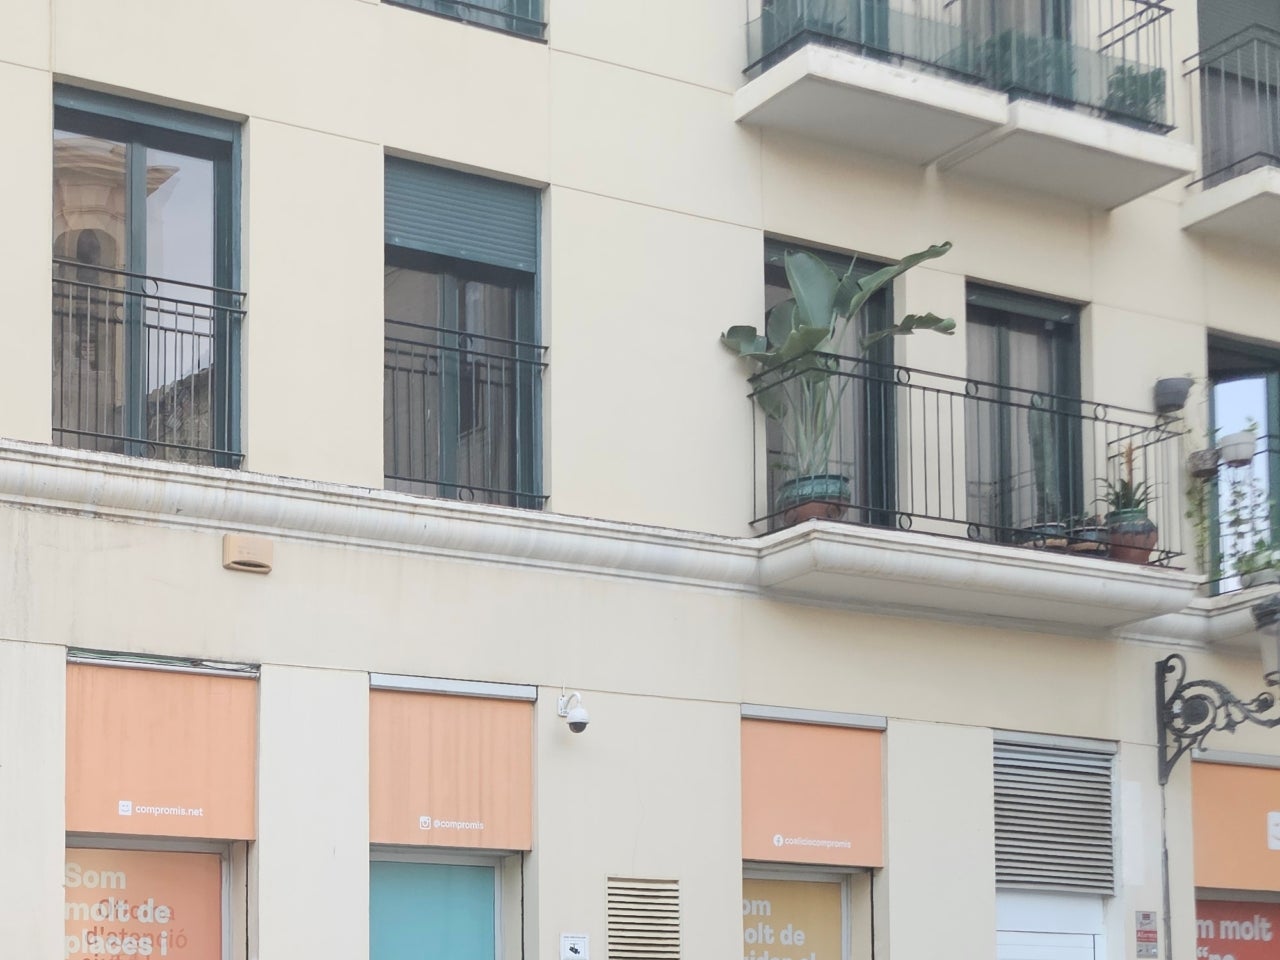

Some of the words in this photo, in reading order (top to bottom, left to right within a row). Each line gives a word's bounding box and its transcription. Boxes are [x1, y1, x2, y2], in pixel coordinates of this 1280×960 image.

[65, 862, 127, 889] Som
[65, 896, 130, 923] molt
[137, 897, 171, 924] de
[742, 899, 771, 916] om
[744, 922, 775, 945] olt
[780, 923, 805, 946] de
[1220, 914, 1274, 942] molt
[64, 928, 153, 960] places
